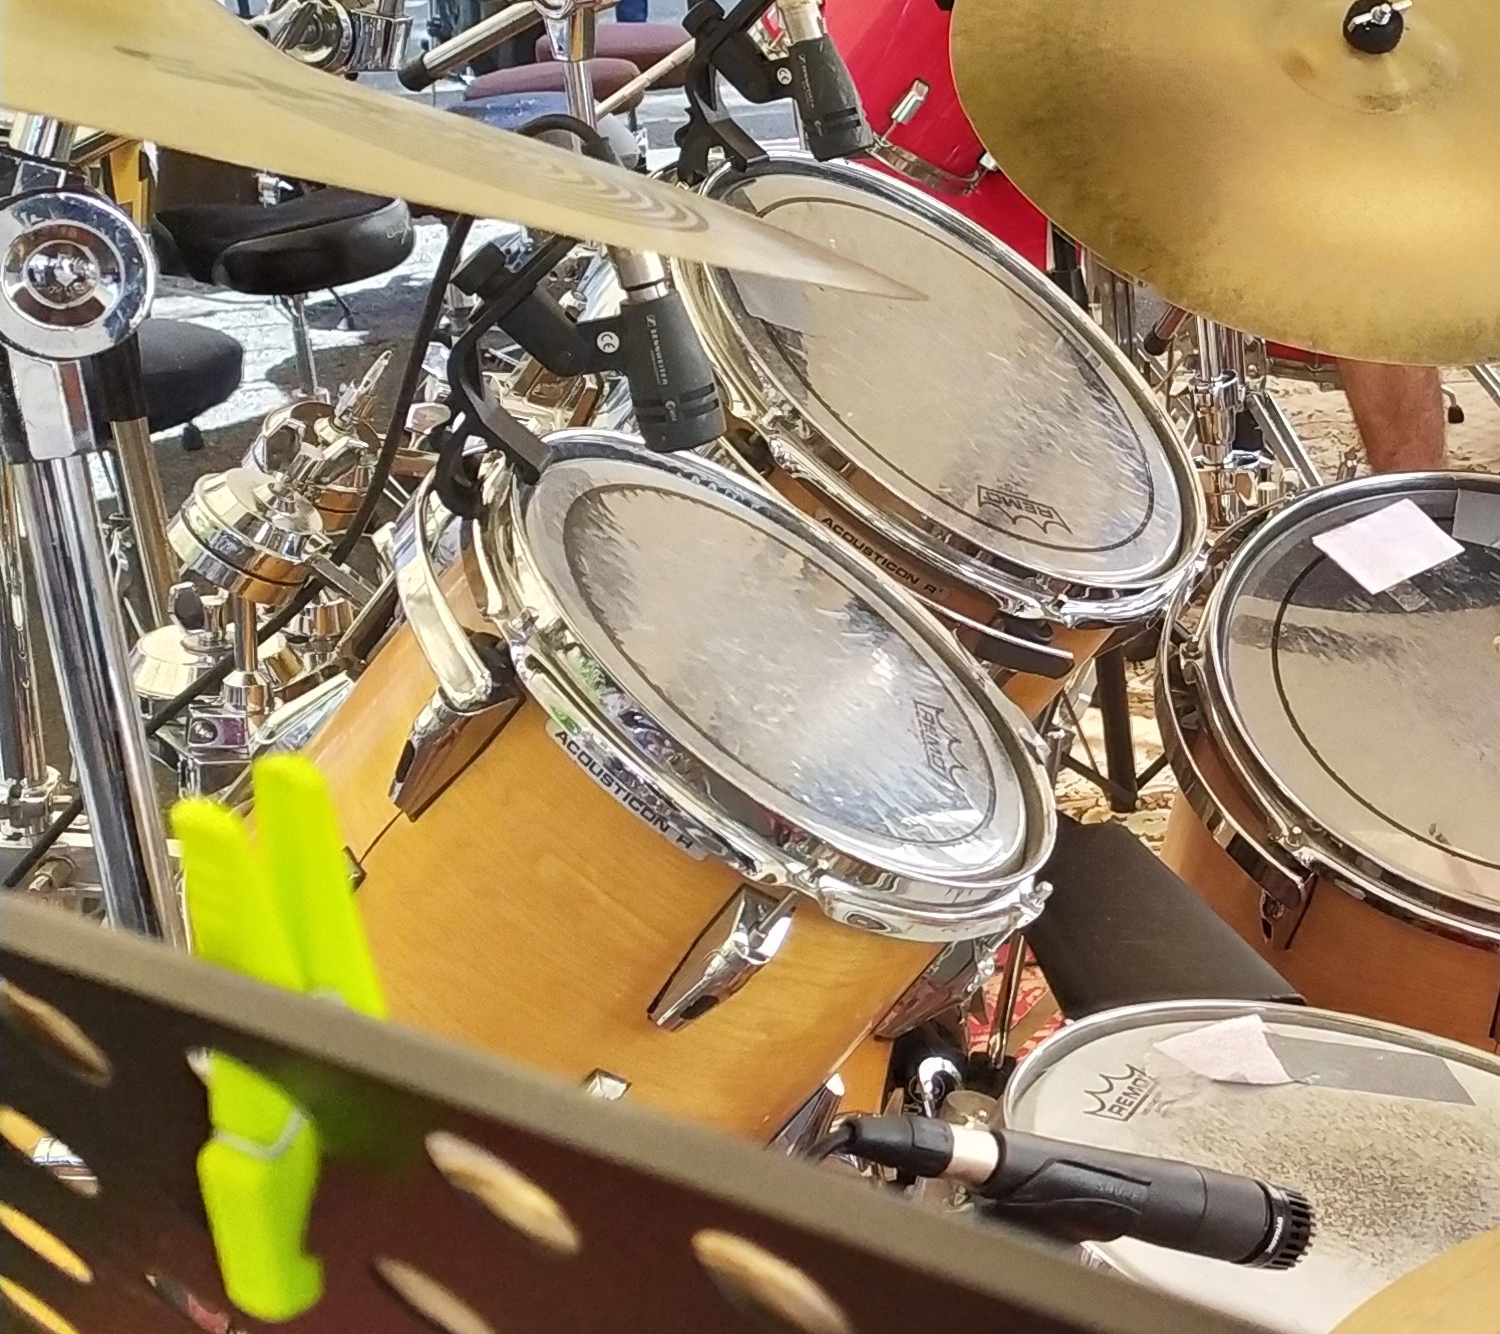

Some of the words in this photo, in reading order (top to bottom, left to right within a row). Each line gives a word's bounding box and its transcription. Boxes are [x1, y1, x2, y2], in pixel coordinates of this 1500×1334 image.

[983, 491, 1054, 520] REMO
[821, 517, 920, 585] ACOUSTICON
[554, 730, 671, 834] ACOUSTICON
[1107, 1076, 1151, 1117] REMO
